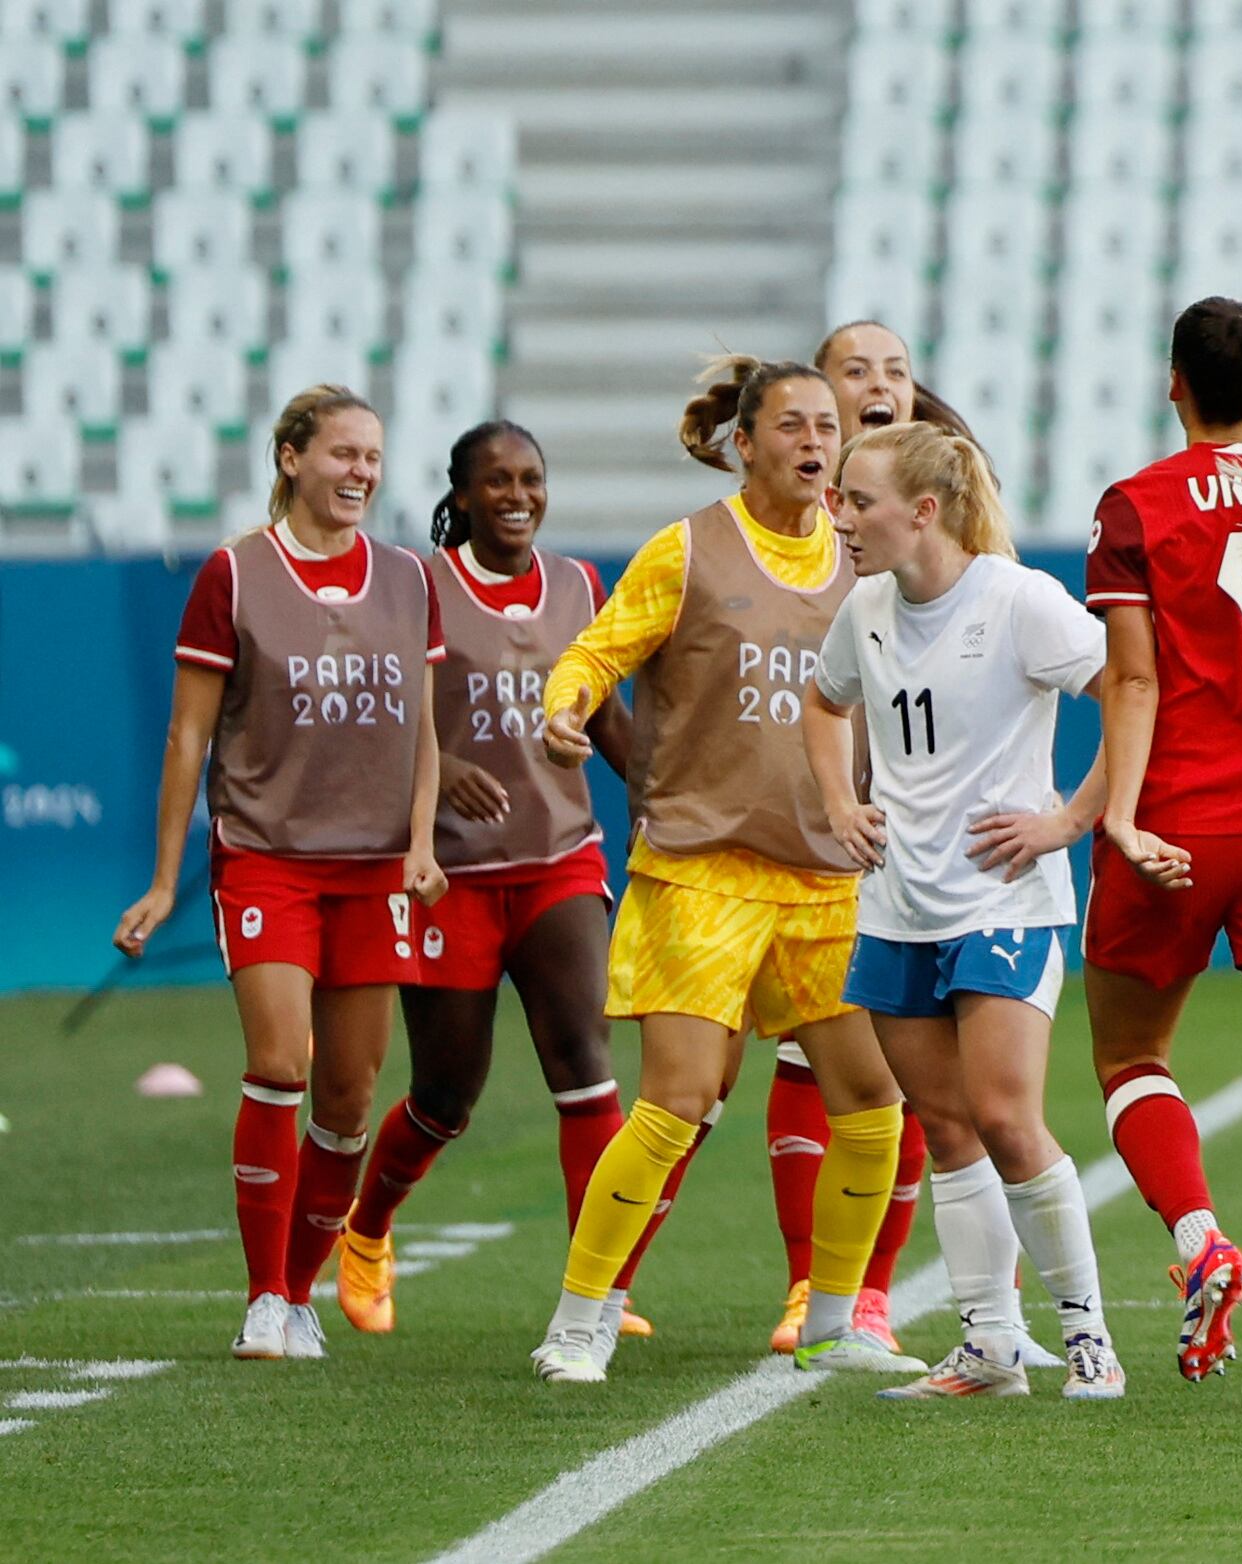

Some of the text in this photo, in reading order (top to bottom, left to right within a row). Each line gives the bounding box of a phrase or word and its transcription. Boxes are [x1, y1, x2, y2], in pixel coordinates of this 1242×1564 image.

[738, 642, 820, 685] PAR
[467, 669, 545, 705] PAR
[737, 685, 802, 726] 20
[292, 691, 405, 726] 2024
[471, 707, 546, 742] 202
[891, 687, 935, 756] 11
